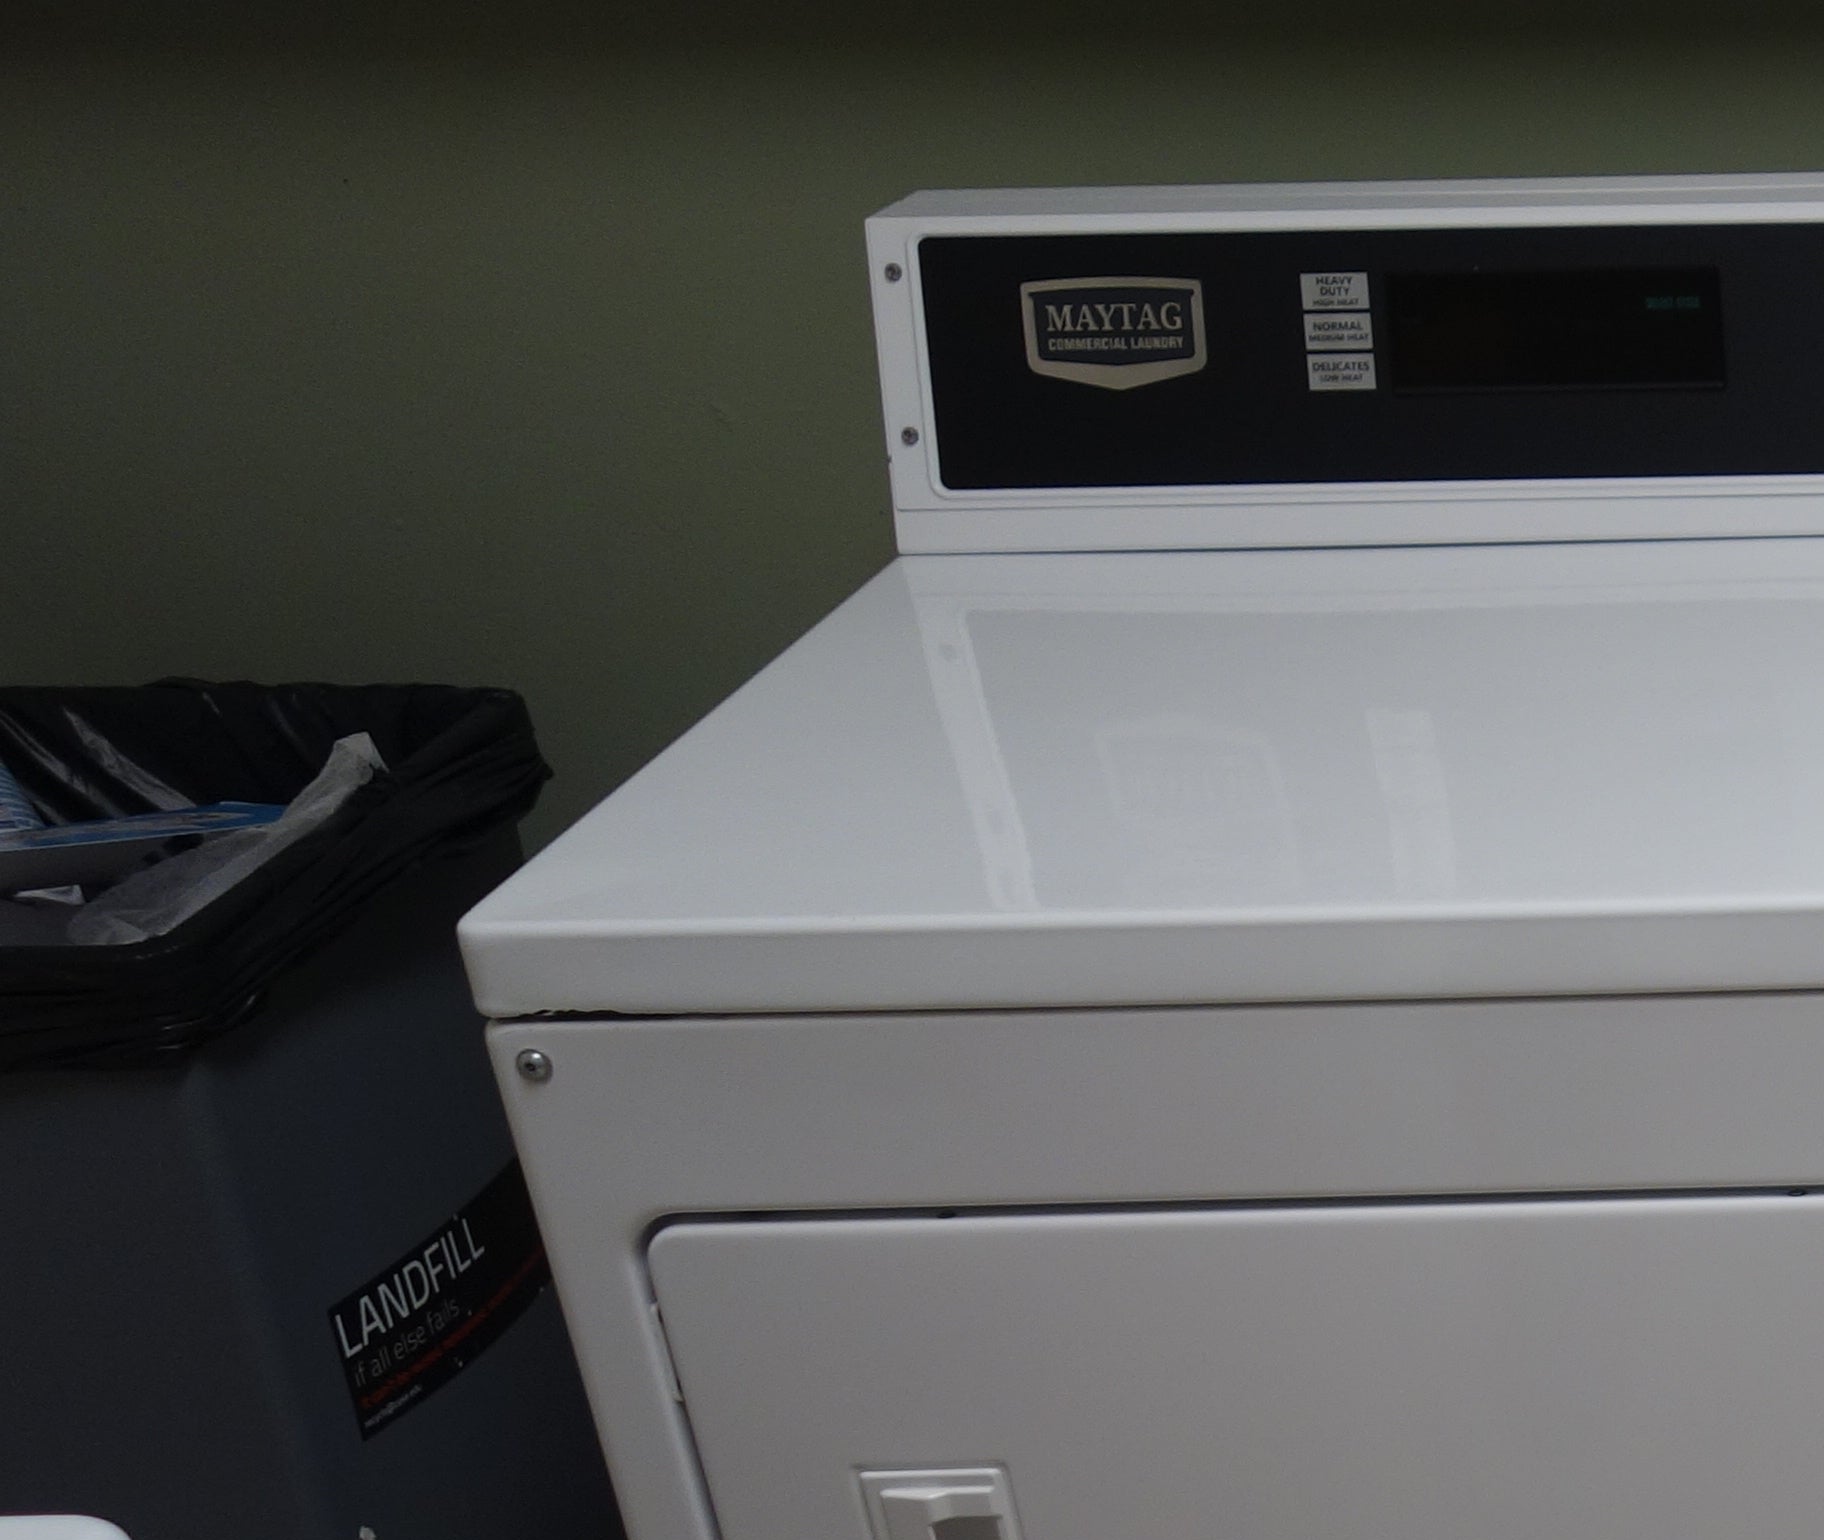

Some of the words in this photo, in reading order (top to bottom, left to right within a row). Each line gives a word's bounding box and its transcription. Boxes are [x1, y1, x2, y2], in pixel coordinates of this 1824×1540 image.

[1316, 276, 1352, 285] HEAVY
[1320, 287, 1350, 296] DUTY
[1045, 302, 1183, 332] MAYTAG
[1313, 322, 1363, 331] NORMAL
[1049, 337, 1127, 350] COMMERCIAL
[1130, 336, 1184, 349] LAUNDRY
[1312, 362, 1369, 371] DELICATES
[335, 1218, 485, 1358] LANDFILL
[354, 1361, 366, 1387] if
[371, 1344, 391, 1378] all
[393, 1326, 427, 1360] else
[426, 1298, 459, 1333] fails
